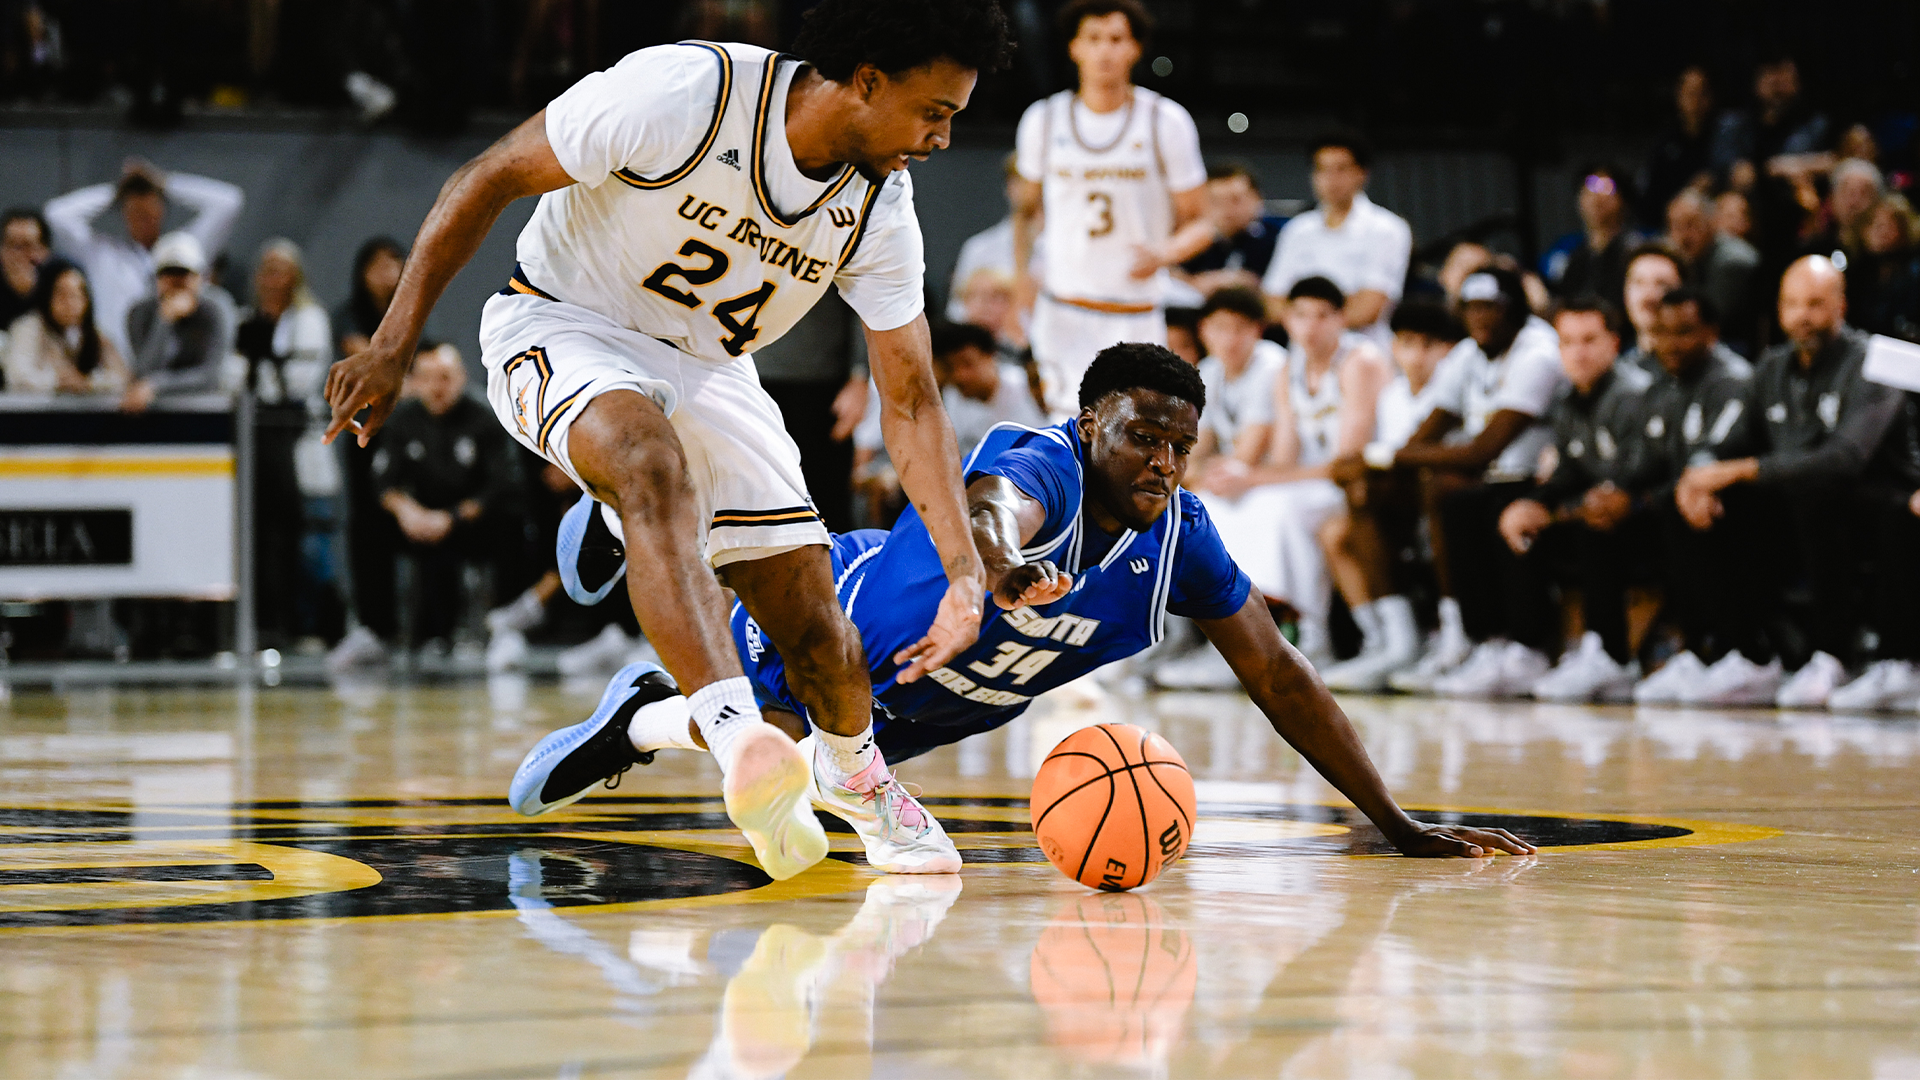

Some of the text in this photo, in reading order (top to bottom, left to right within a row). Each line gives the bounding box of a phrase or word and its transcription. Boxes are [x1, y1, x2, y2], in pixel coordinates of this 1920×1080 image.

[716, 155, 741, 171] adidas
[1086, 191, 1115, 239] 3
[677, 194, 828, 284] UC IRVINE
[641, 236, 779, 358] 24
[1001, 605, 1101, 648] SANTA
[967, 641, 1063, 685] 34
